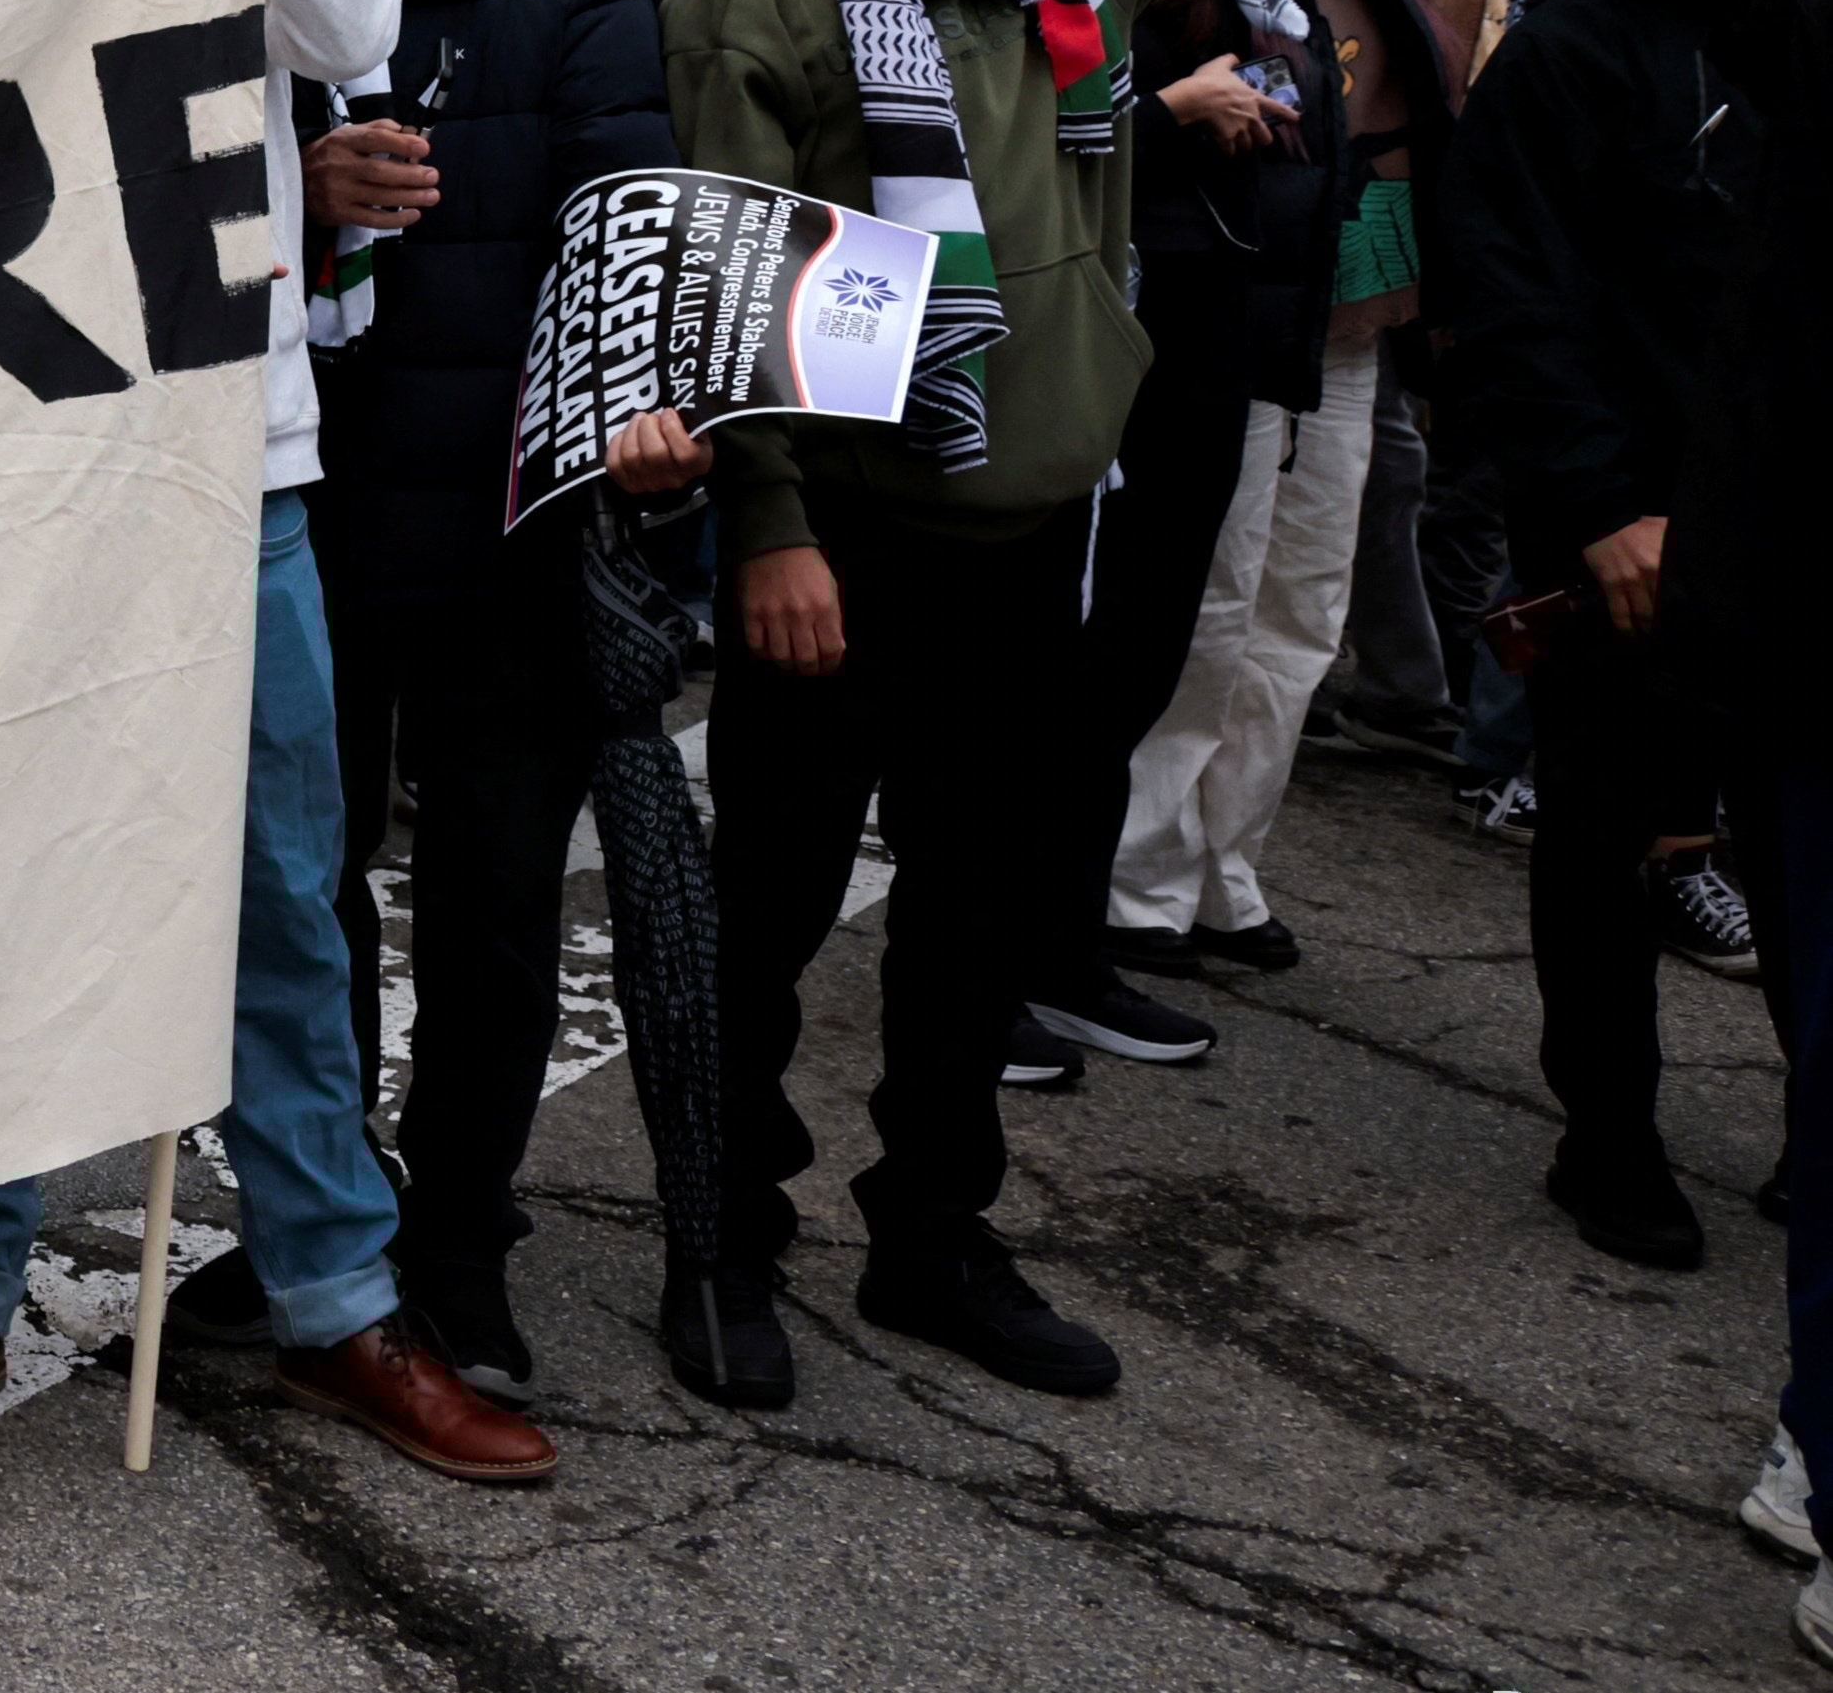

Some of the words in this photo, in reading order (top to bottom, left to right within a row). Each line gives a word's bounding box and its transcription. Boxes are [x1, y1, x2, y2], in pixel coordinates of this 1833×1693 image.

[686, 185, 731, 244] JEWS
[737, 198, 769, 235] Mich.
[763, 196, 800, 251] Senators
[682, 250, 716, 266] &
[750, 253, 785, 299] Peters
[668, 272, 711, 354] ALLIES
[705, 238, 760, 395] Congressmembers
[748, 303, 773, 314] &
[814, 307, 833, 337] DETROIT
[828, 309, 849, 339] PEACE
[846, 313, 865, 339] VOICE
[861, 314, 880, 345] JEWISH
[554, 192, 600, 479] DE-ESCALATE
[730, 318, 770, 402] Stabenow
[668, 357, 696, 410] SAY
